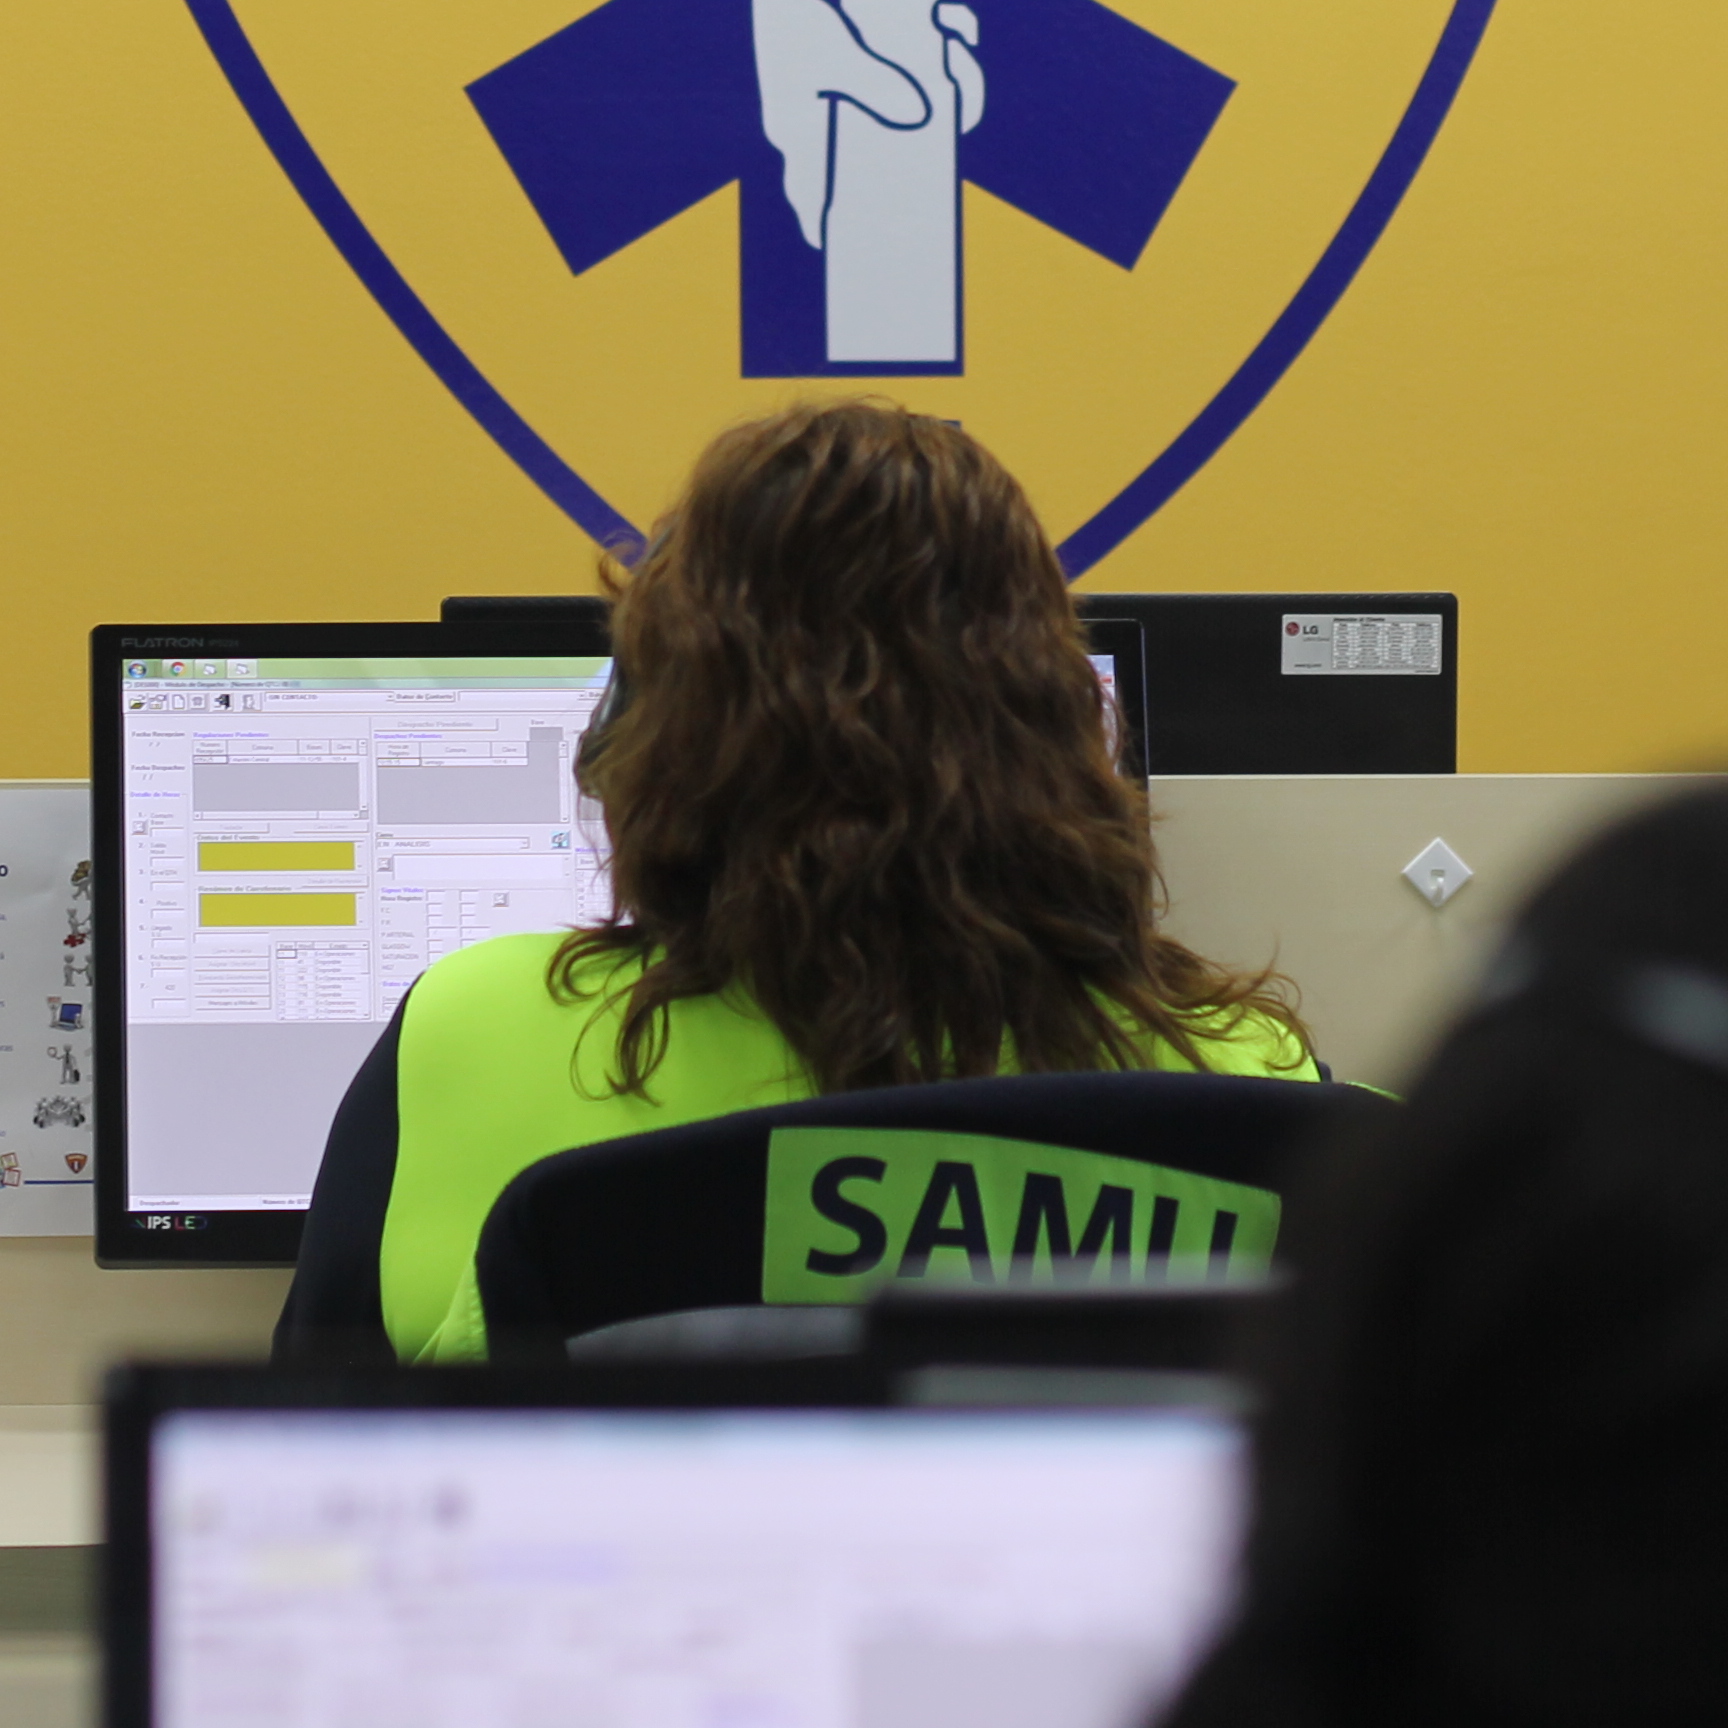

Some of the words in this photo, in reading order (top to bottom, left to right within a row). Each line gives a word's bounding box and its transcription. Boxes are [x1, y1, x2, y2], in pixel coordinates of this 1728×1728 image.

[1303, 625, 1318, 635] LG
[121, 638, 203, 648] FLATRON
[147, 1216, 171, 1229] IPS
[805, 1156, 1239, 1284] SAMU
